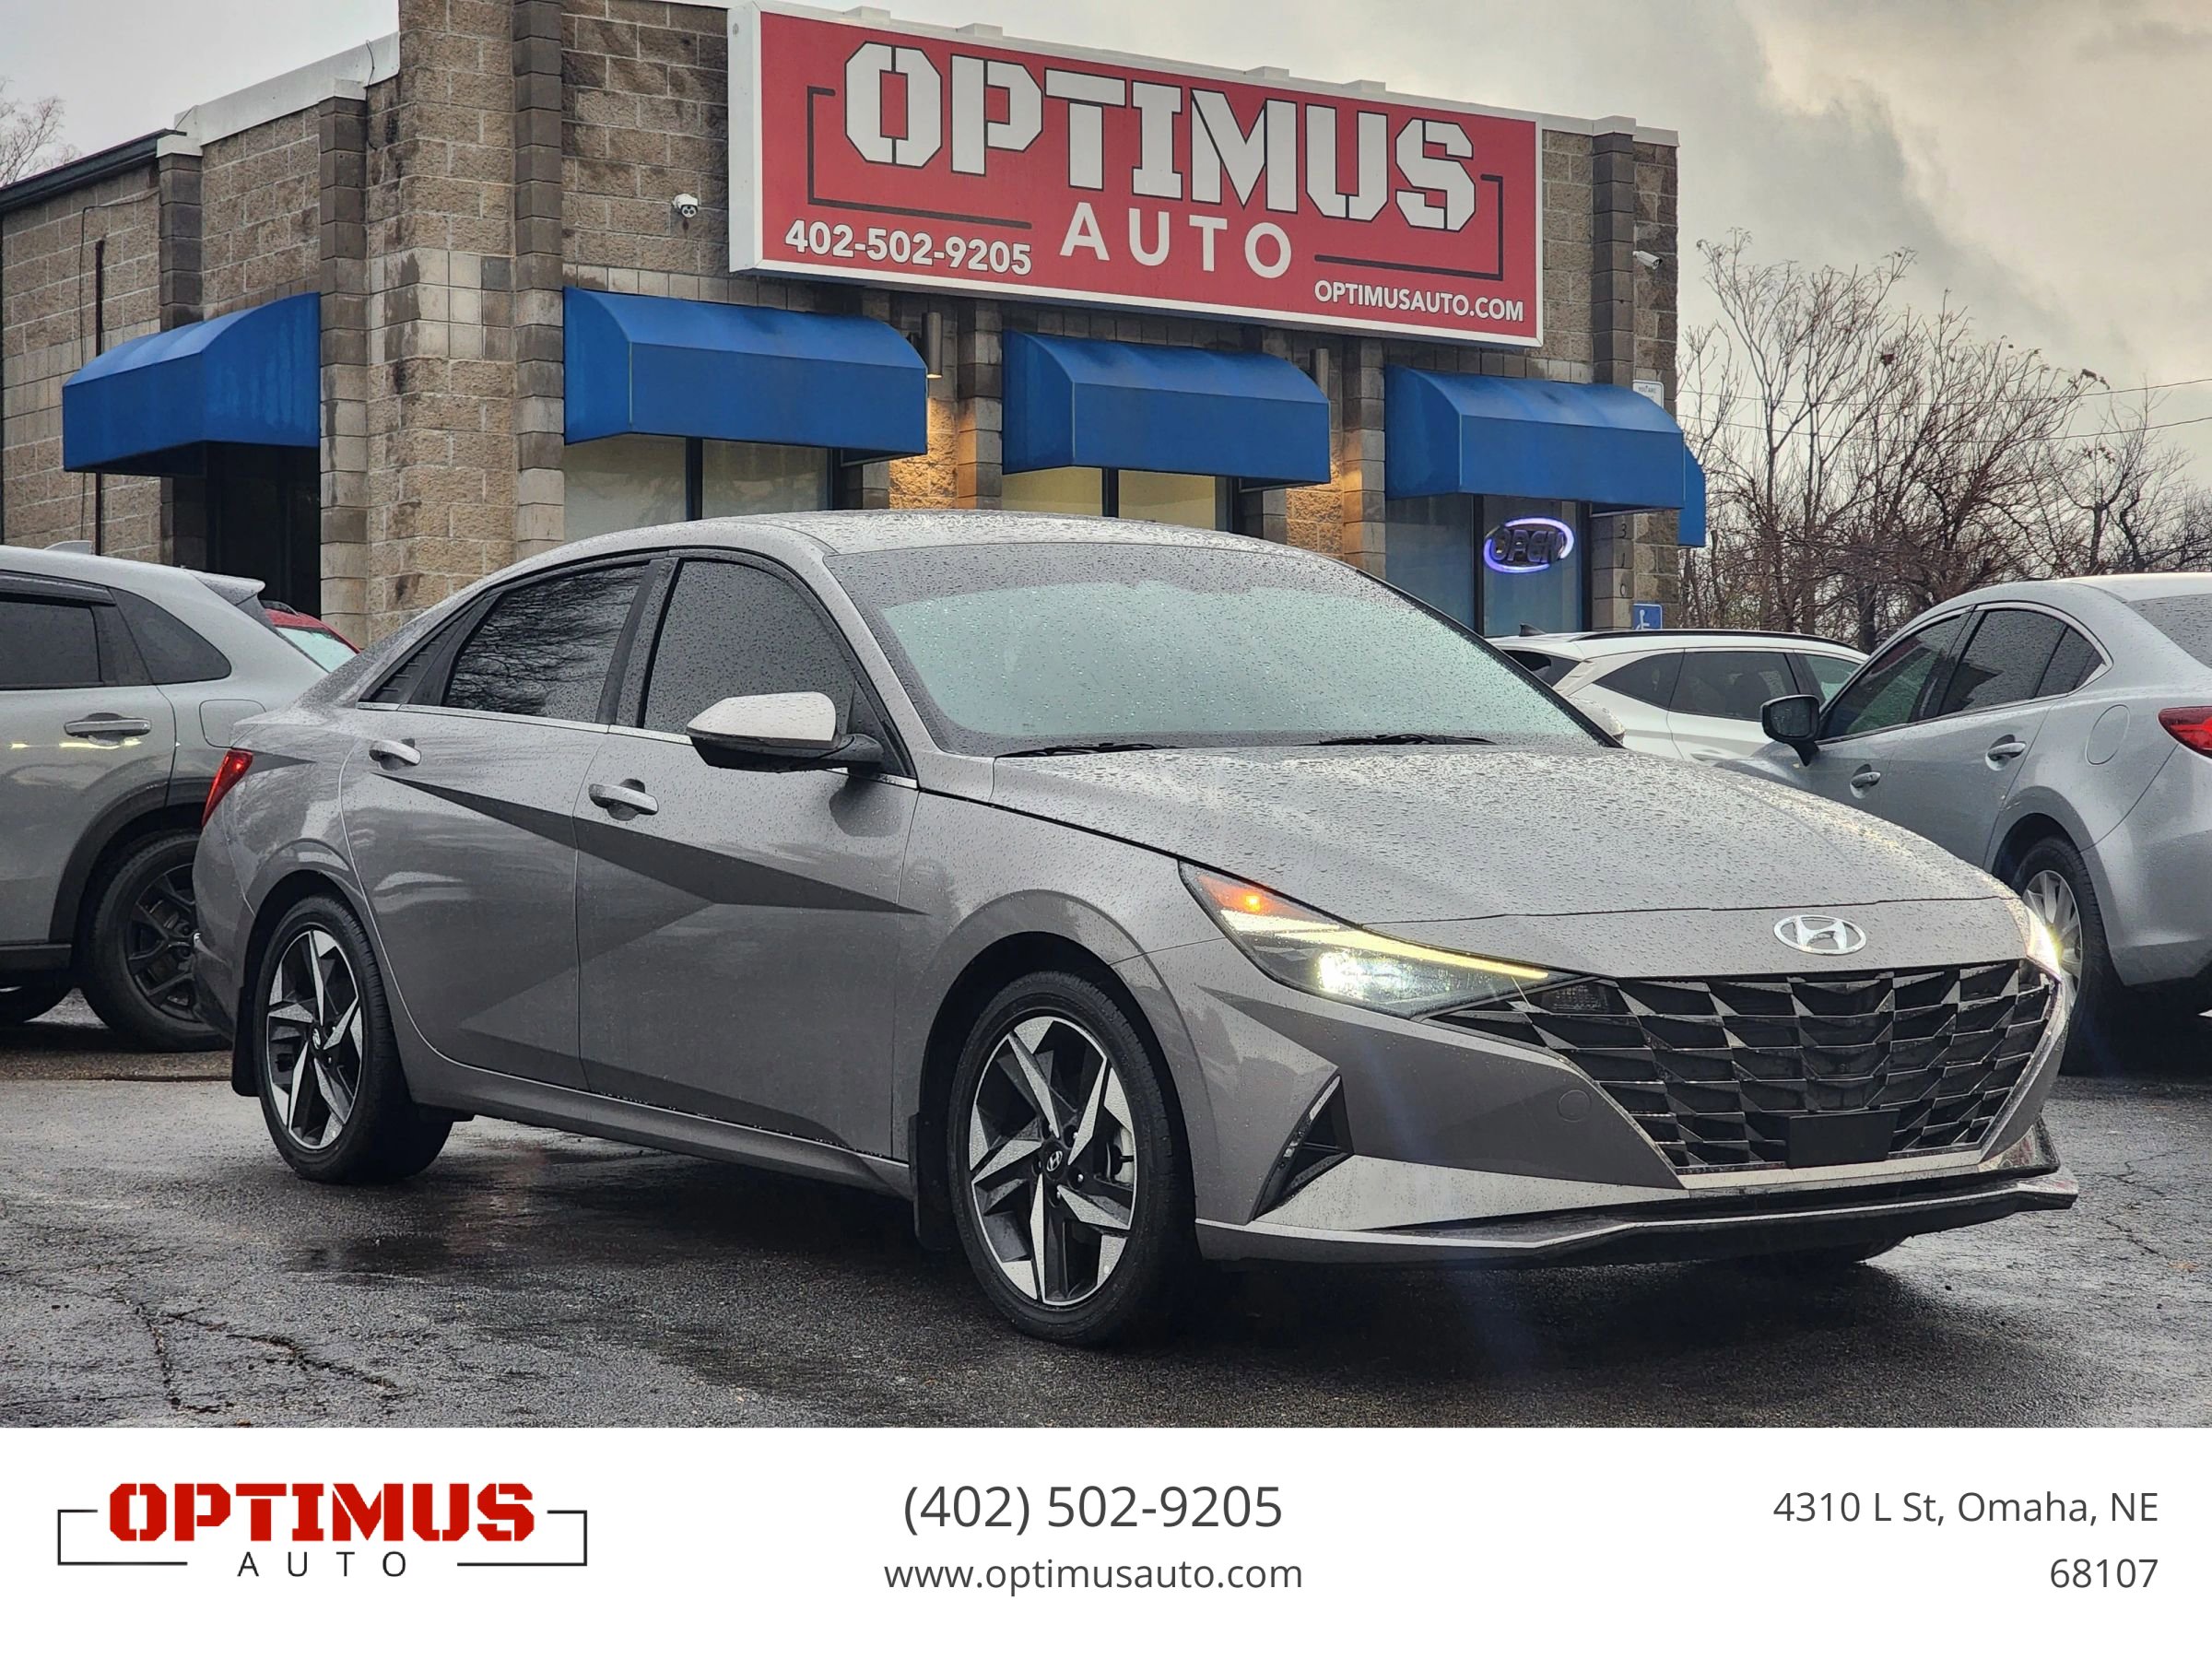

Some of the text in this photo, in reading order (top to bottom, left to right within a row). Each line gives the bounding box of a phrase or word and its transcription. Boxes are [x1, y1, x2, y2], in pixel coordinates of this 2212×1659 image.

[845, 41, 1476, 232] OPTIMUS
[784, 218, 1033, 277] 402-502-9205
[1059, 203, 1291, 278] AUTO
[1313, 279, 1525, 324] OPTIMUSAUTO.COM
